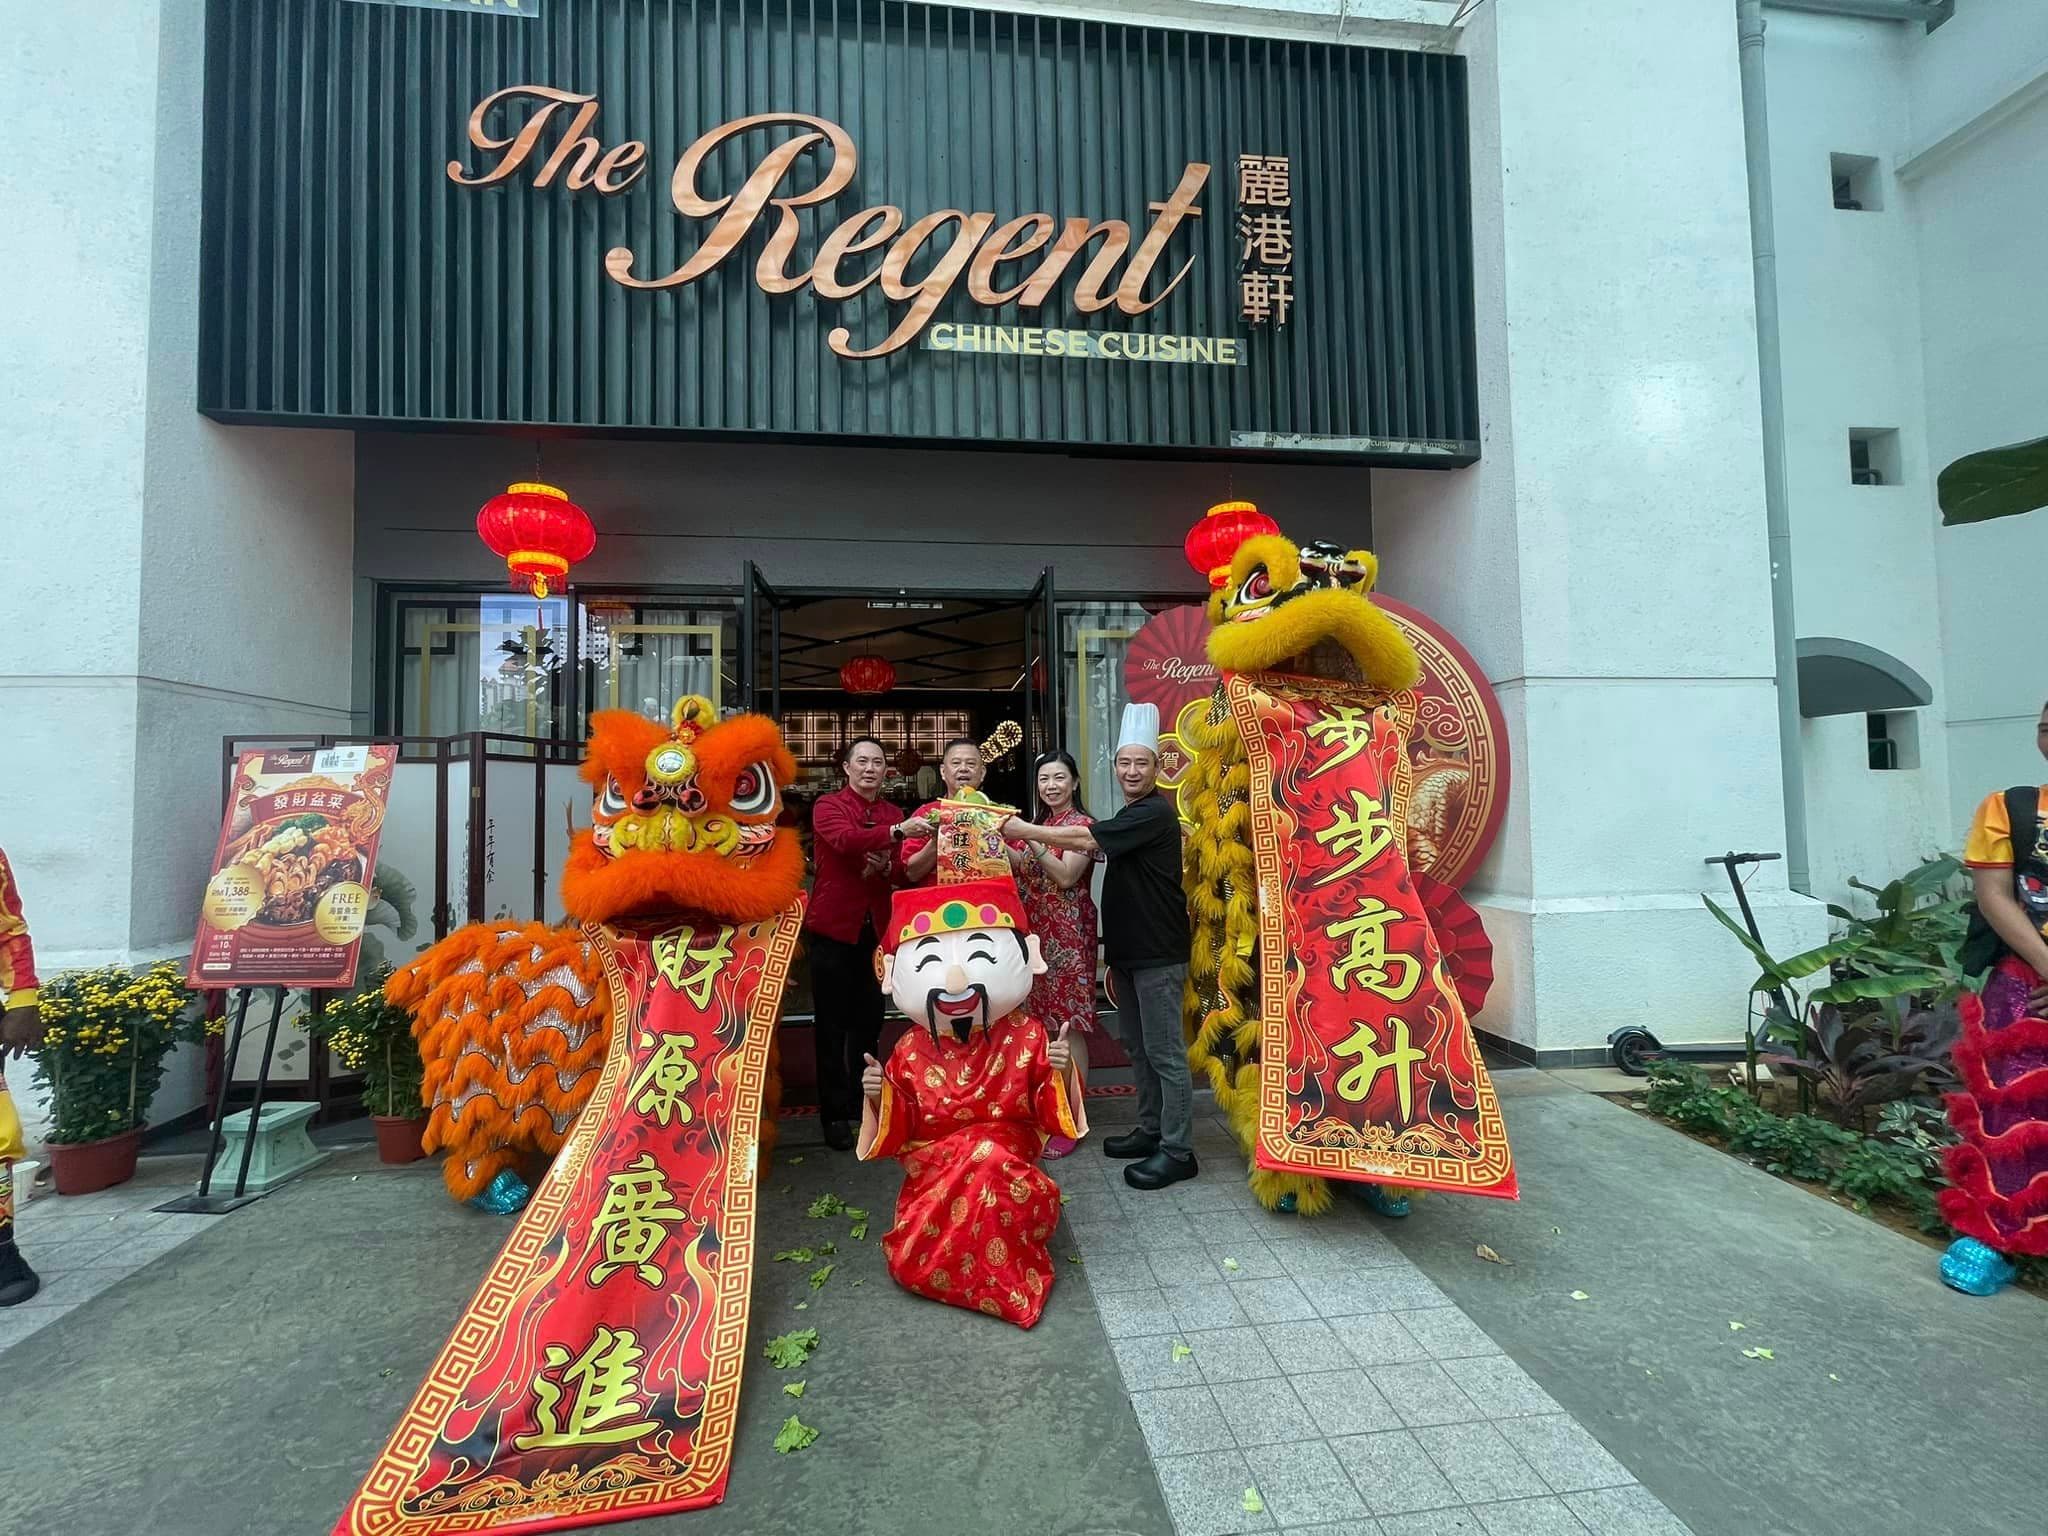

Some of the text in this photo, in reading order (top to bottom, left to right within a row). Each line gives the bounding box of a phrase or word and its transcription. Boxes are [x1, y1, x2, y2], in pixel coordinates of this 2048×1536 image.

[447, 85, 1212, 359] The Regent
[1238, 153, 1295, 329] 麗港軒
[929, 323, 1238, 365] CHINESE CUISINE
[1143, 658, 1160, 670] The
[1160, 751, 1180, 770] 賀
[331, 893, 362, 904] FREE
[1303, 704, 1429, 1125] 步步高升
[511, 924, 738, 1454] 財源廣進
